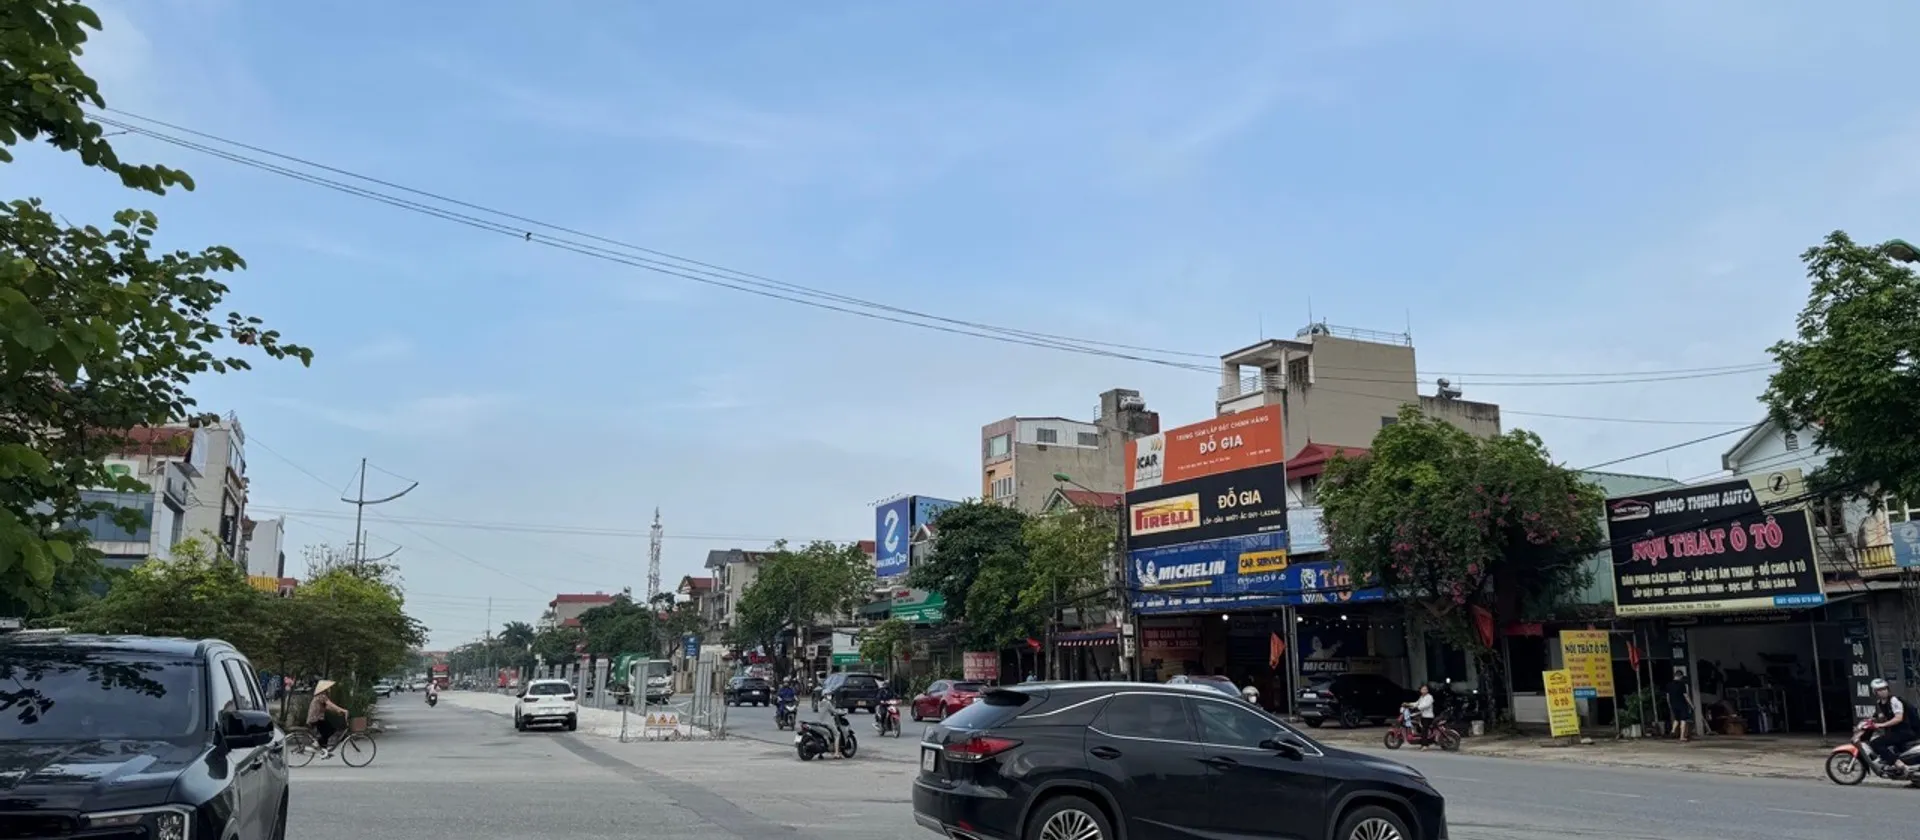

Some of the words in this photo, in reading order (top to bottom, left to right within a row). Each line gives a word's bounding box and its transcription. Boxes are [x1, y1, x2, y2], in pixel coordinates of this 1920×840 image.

[1221, 434, 1243, 449] GIA
[1217, 487, 1237, 509] ĐỖ
[1239, 489, 1262, 506] GIA
[1655, 497, 1685, 514] HƯNG
[1688, 493, 1720, 513] THỊNH
[1722, 488, 1751, 505] AUTO
[1135, 507, 1193, 530] PIRELLI
[1632, 529, 1667, 566] NỘI
[1669, 520, 1725, 557] THẤT
[1730, 521, 1747, 552] Ô
[1751, 514, 1783, 549] TÔ
[1158, 560, 1226, 580] MICHELIN
[1240, 558, 1253, 568] CAR
[1257, 555, 1283, 566] SERVICE
[1651, 572, 1667, 583] CÁCH
[1691, 567, 1703, 581] LẮP
[1719, 566, 1730, 579] ÂM
[1731, 566, 1754, 577] THANH
[1789, 559, 1796, 573] Ô
[1796, 558, 1806, 572] TÔ
[1668, 586, 1690, 596] CAMERA
